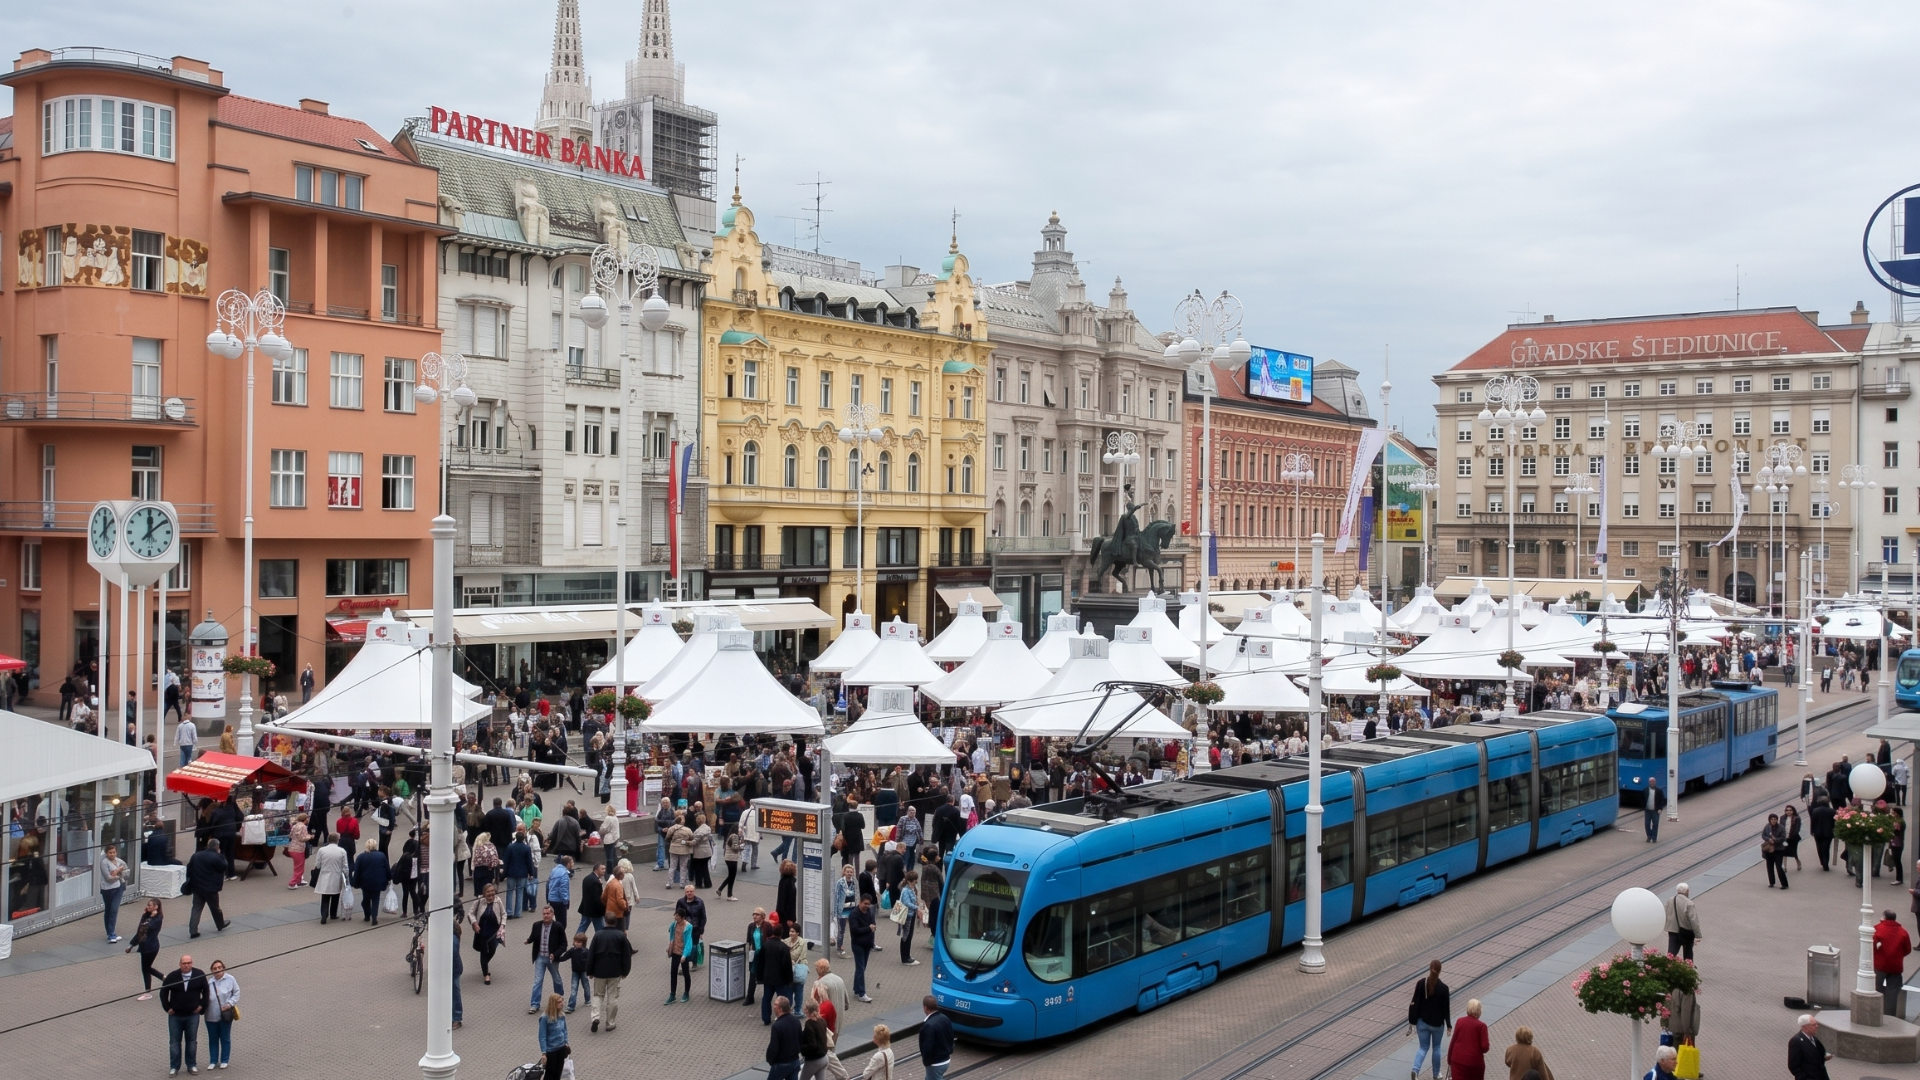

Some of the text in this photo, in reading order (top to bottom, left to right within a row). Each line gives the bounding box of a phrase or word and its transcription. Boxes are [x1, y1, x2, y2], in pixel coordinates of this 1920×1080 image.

[430, 105, 646, 180] PARTNER BANKA
[1511, 341, 1620, 363] GRADSKE
